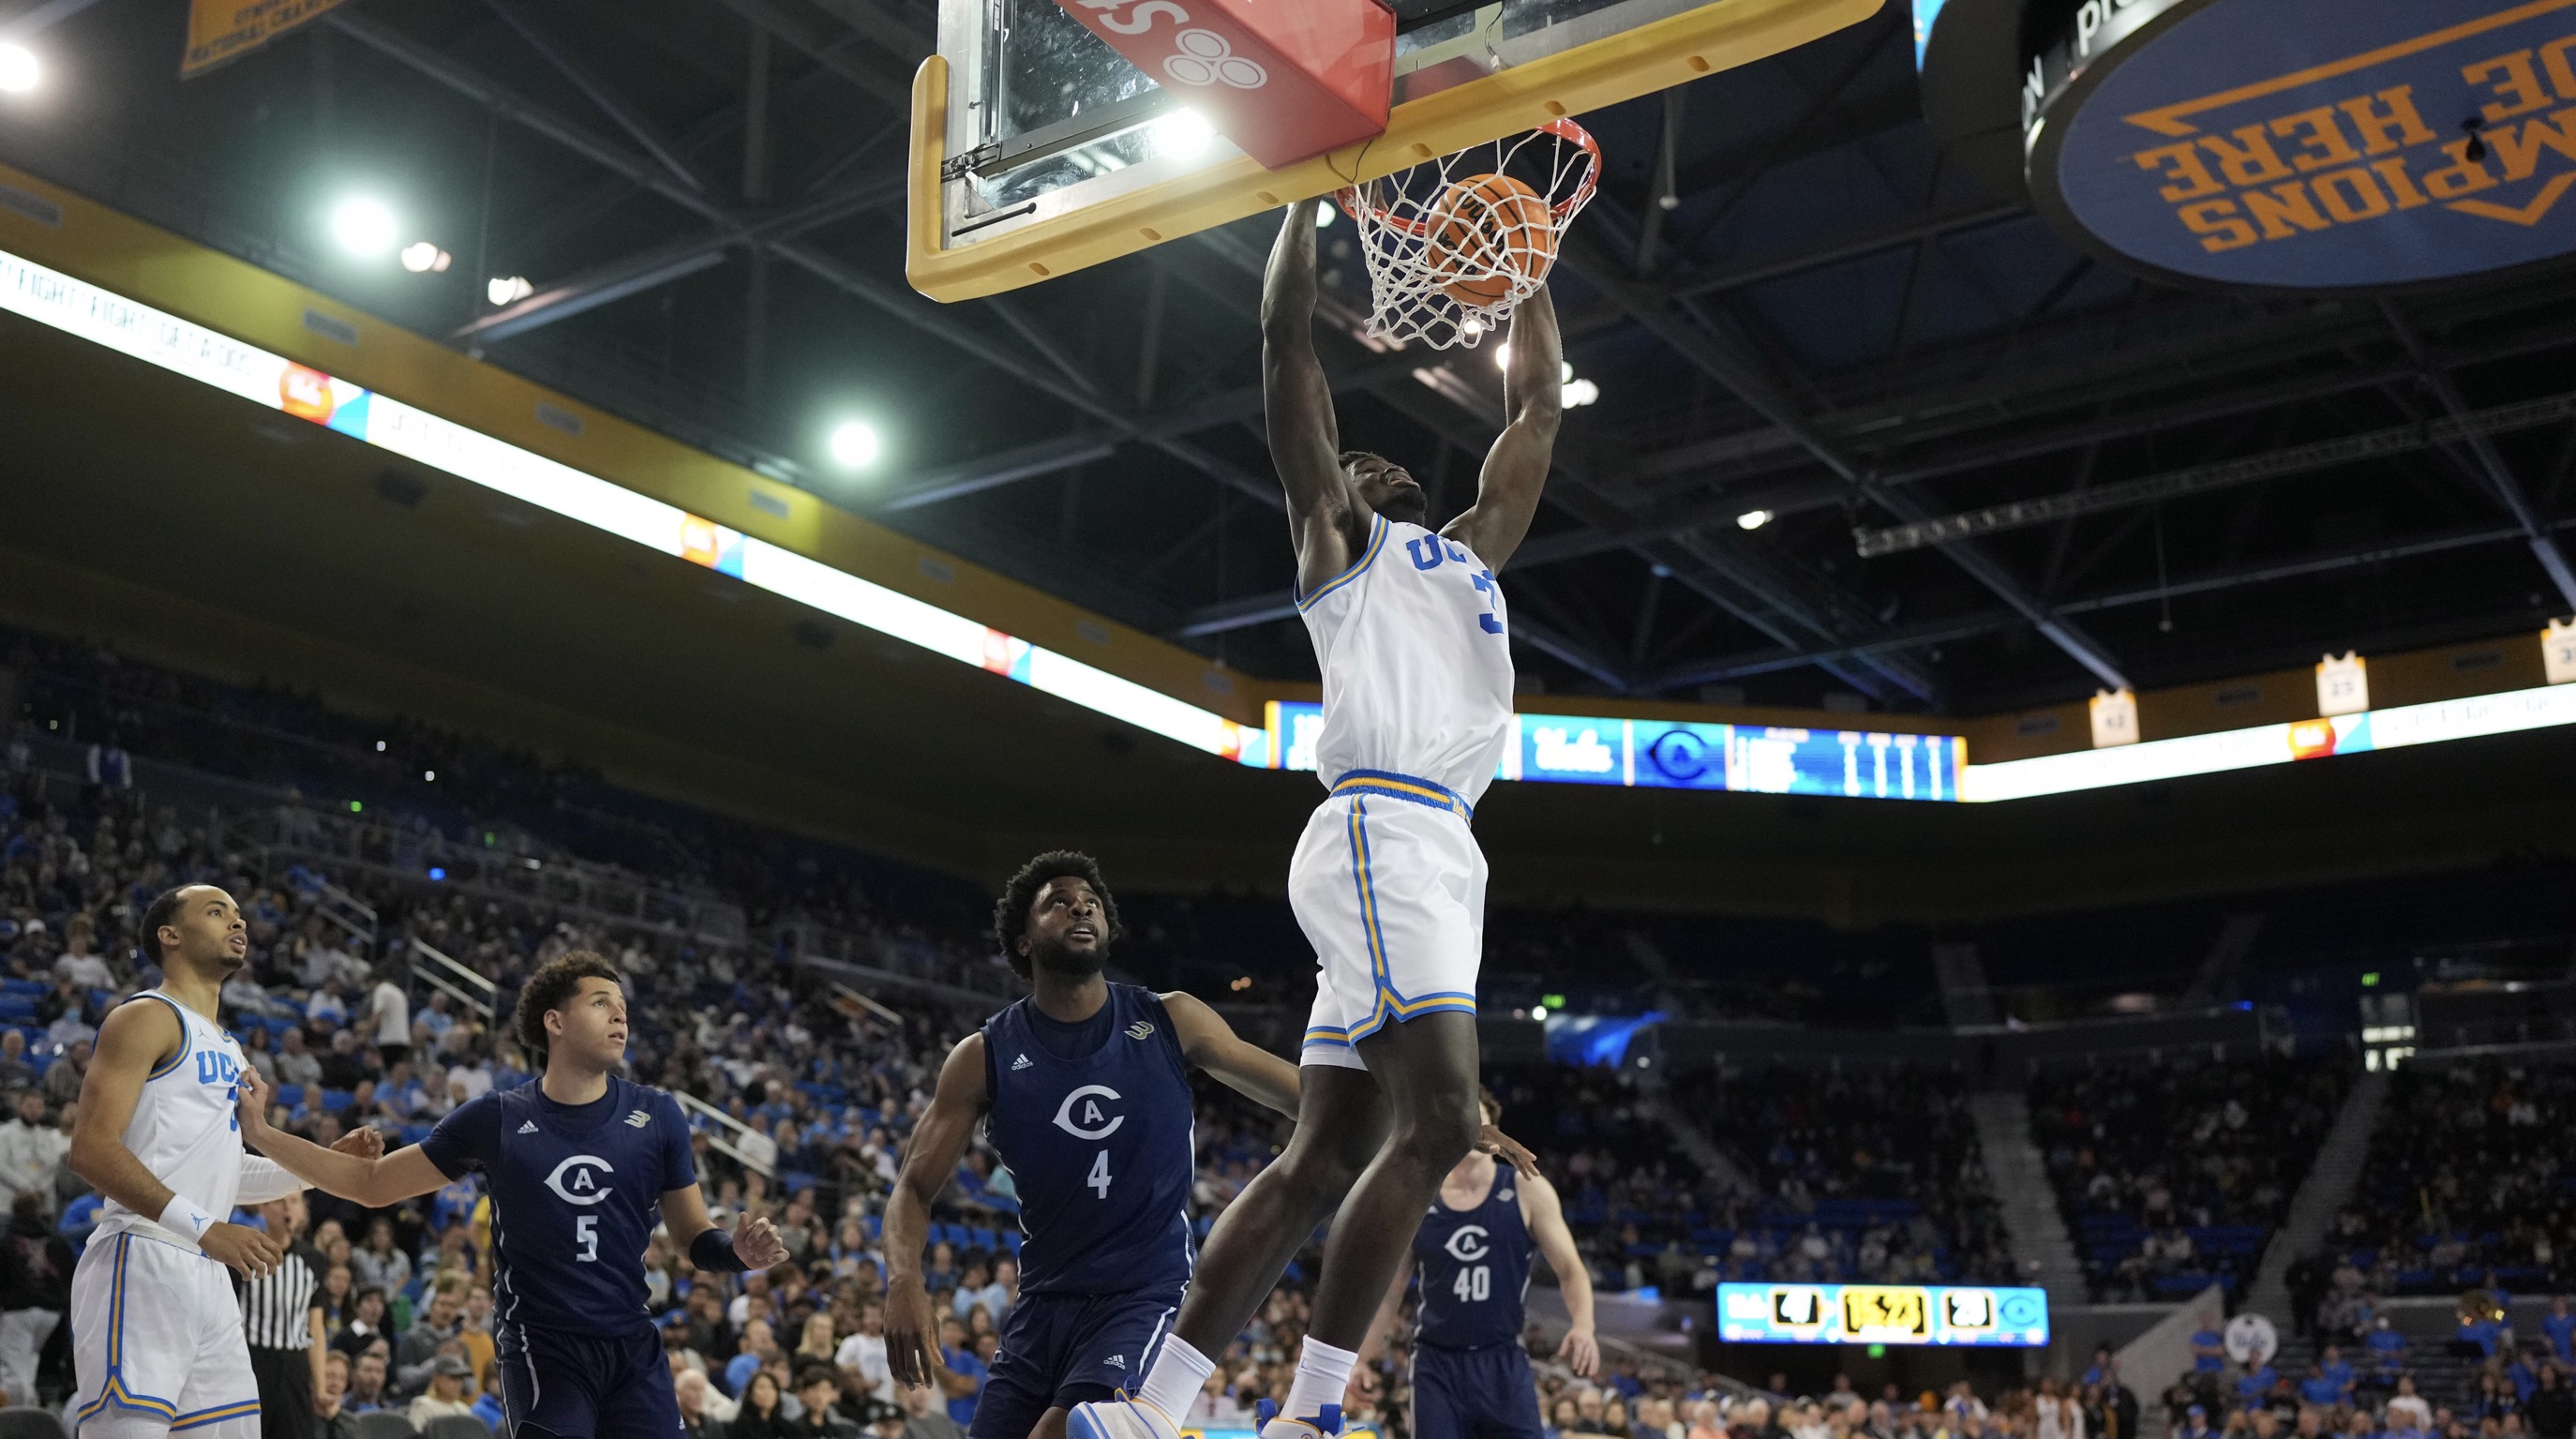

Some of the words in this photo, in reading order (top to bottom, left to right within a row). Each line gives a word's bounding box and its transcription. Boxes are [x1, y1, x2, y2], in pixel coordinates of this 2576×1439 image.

[2133, 84, 2436, 203] HERE
[1406, 533, 1469, 571] UC
[1011, 1061, 1033, 1071] adidas
[1086, 1149, 1113, 1200] 4
[576, 1215, 599, 1263] 5
[1453, 1266, 1490, 1303] 40
